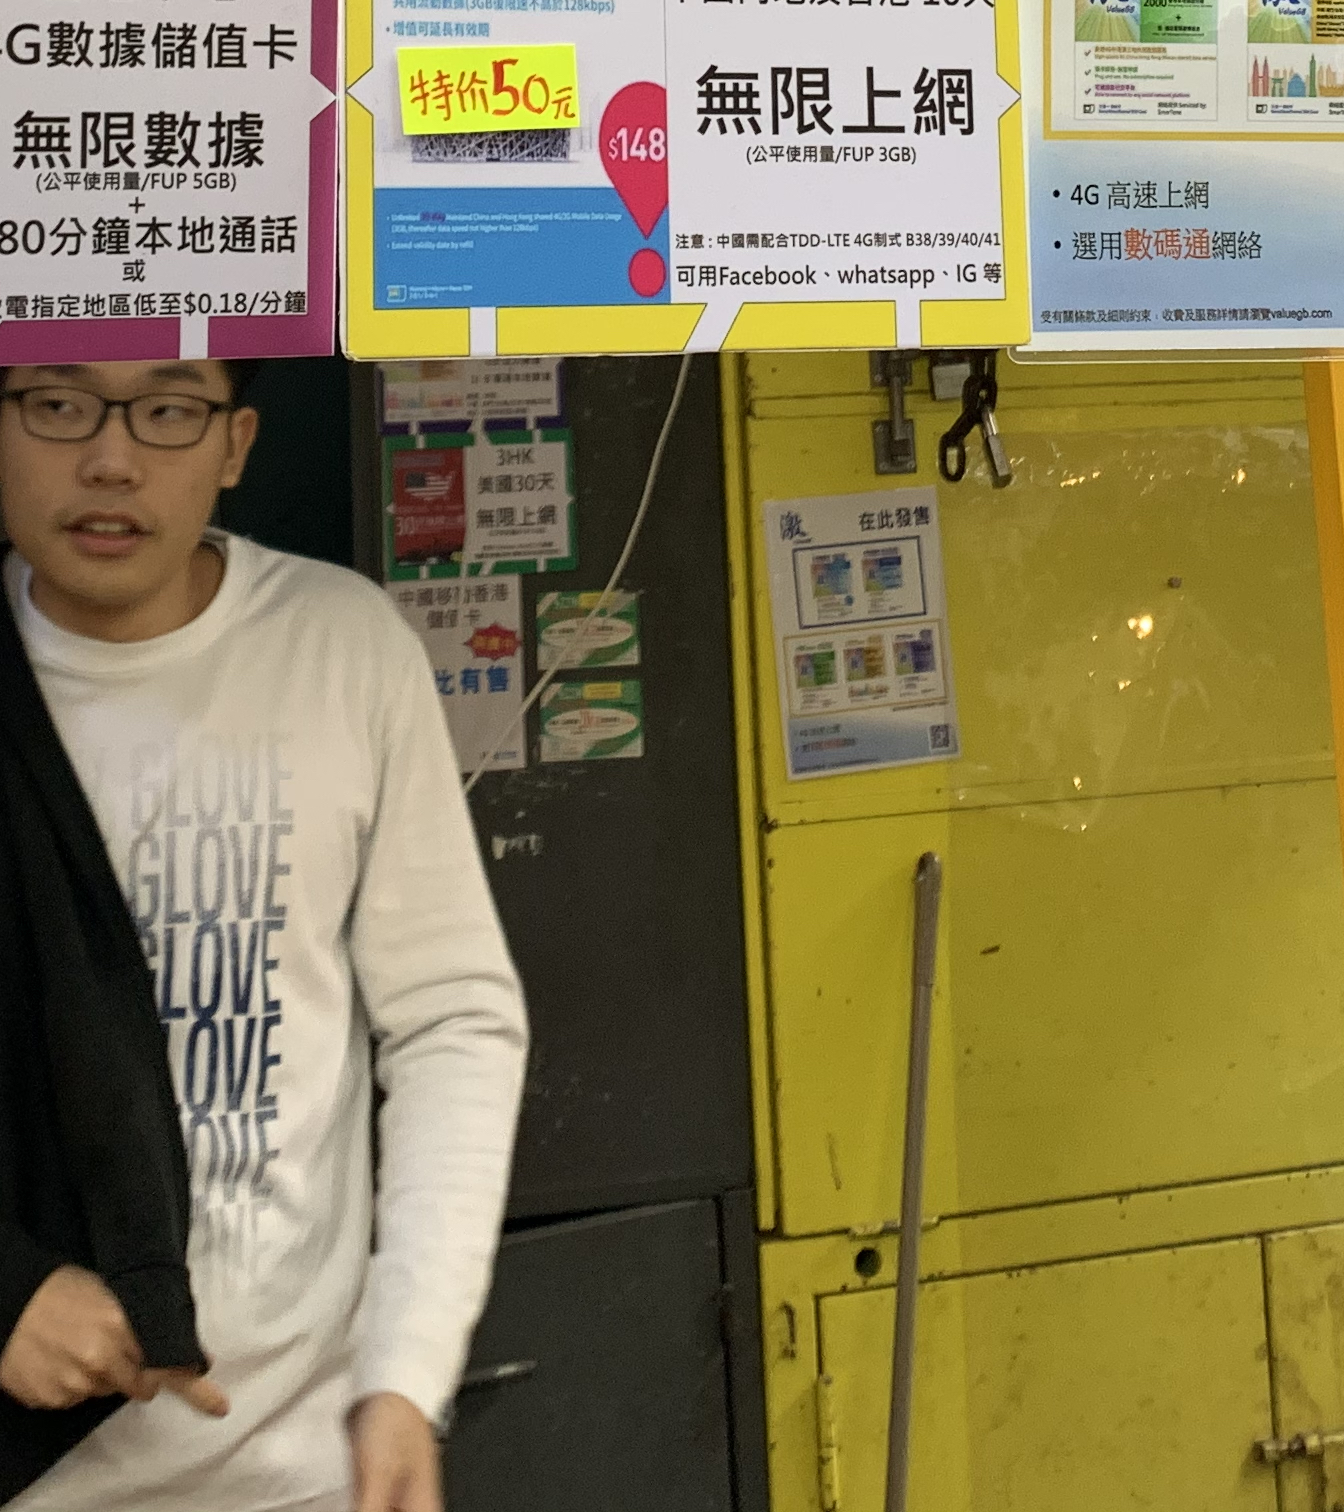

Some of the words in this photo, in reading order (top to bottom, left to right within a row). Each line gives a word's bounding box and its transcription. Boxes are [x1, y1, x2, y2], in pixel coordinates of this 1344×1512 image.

[694, 64, 975, 139] 無限上網
[11, 110, 265, 171] 無限數據
[608, 126, 665, 163] $148
[1070, 183, 1100, 208] 4G
[1107, 180, 1209, 210] 高速上網
[1072, 228, 1262, 262] 選用數碼通網絡
